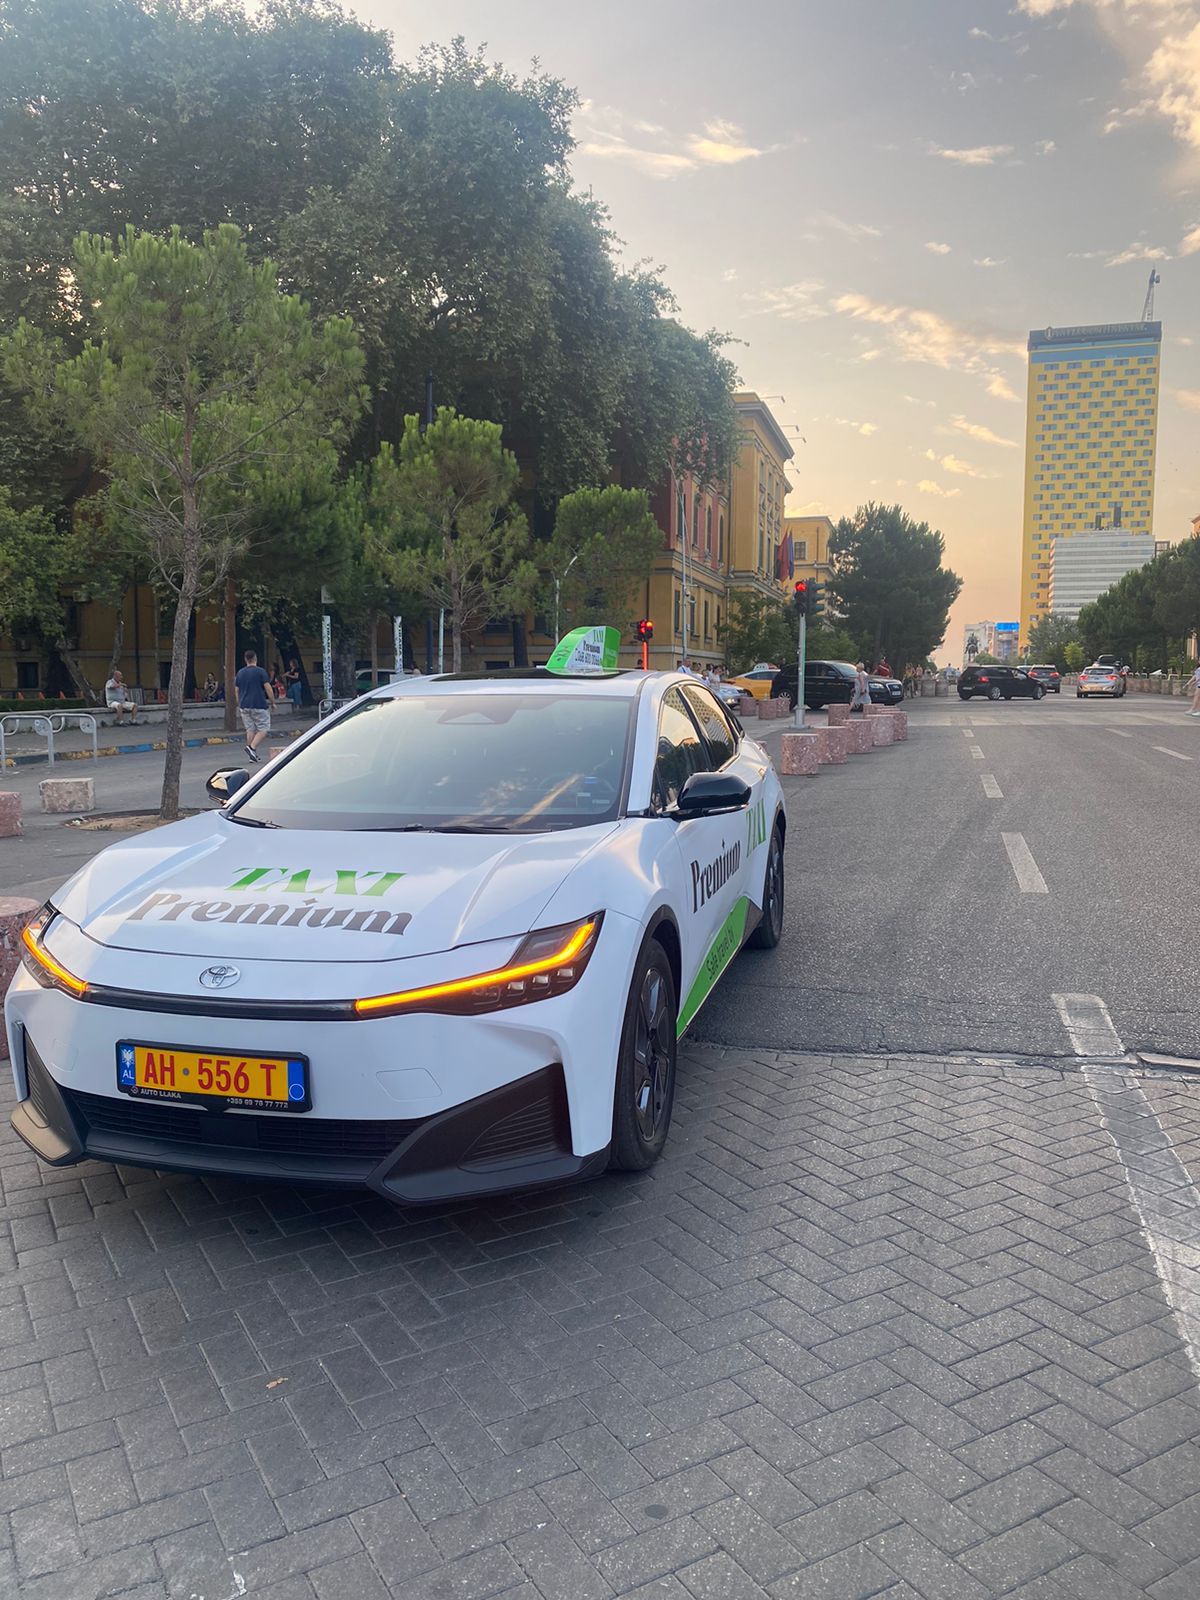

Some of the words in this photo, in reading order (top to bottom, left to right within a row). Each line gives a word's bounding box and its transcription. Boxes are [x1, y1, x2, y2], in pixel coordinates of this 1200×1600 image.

[223, 867, 408, 897] TAXI
[690, 838, 741, 914] Premium
[126, 893, 413, 936] Premium
[122, 1069, 135, 1080] AL
[140, 1088, 158, 1096] AUTO
[144, 1052, 175, 1087] AH
[198, 1058, 250, 1092] 556
[260, 1063, 277, 1097] T
